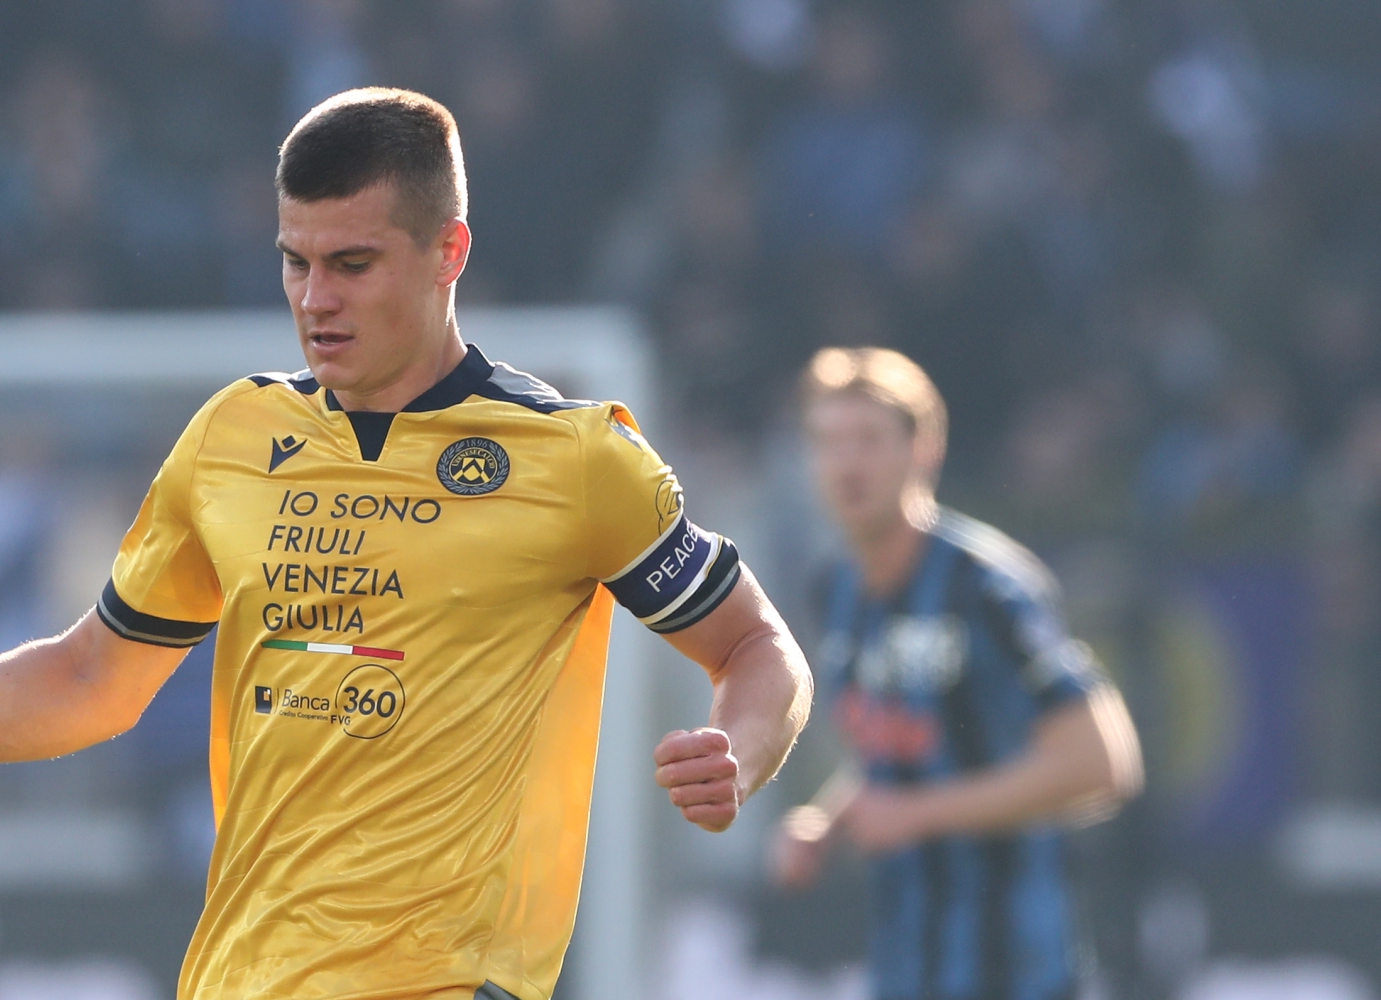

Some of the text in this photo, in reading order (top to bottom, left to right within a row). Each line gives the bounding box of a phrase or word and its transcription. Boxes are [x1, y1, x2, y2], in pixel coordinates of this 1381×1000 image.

[278, 489, 442, 524] IO SONO
[268, 525, 366, 556] FRIULI
[262, 562, 404, 600] VENEZIA
[262, 602, 364, 634] GIULIA
[282, 686, 396, 719] Banca 360
[330, 714, 351, 726] FVG
